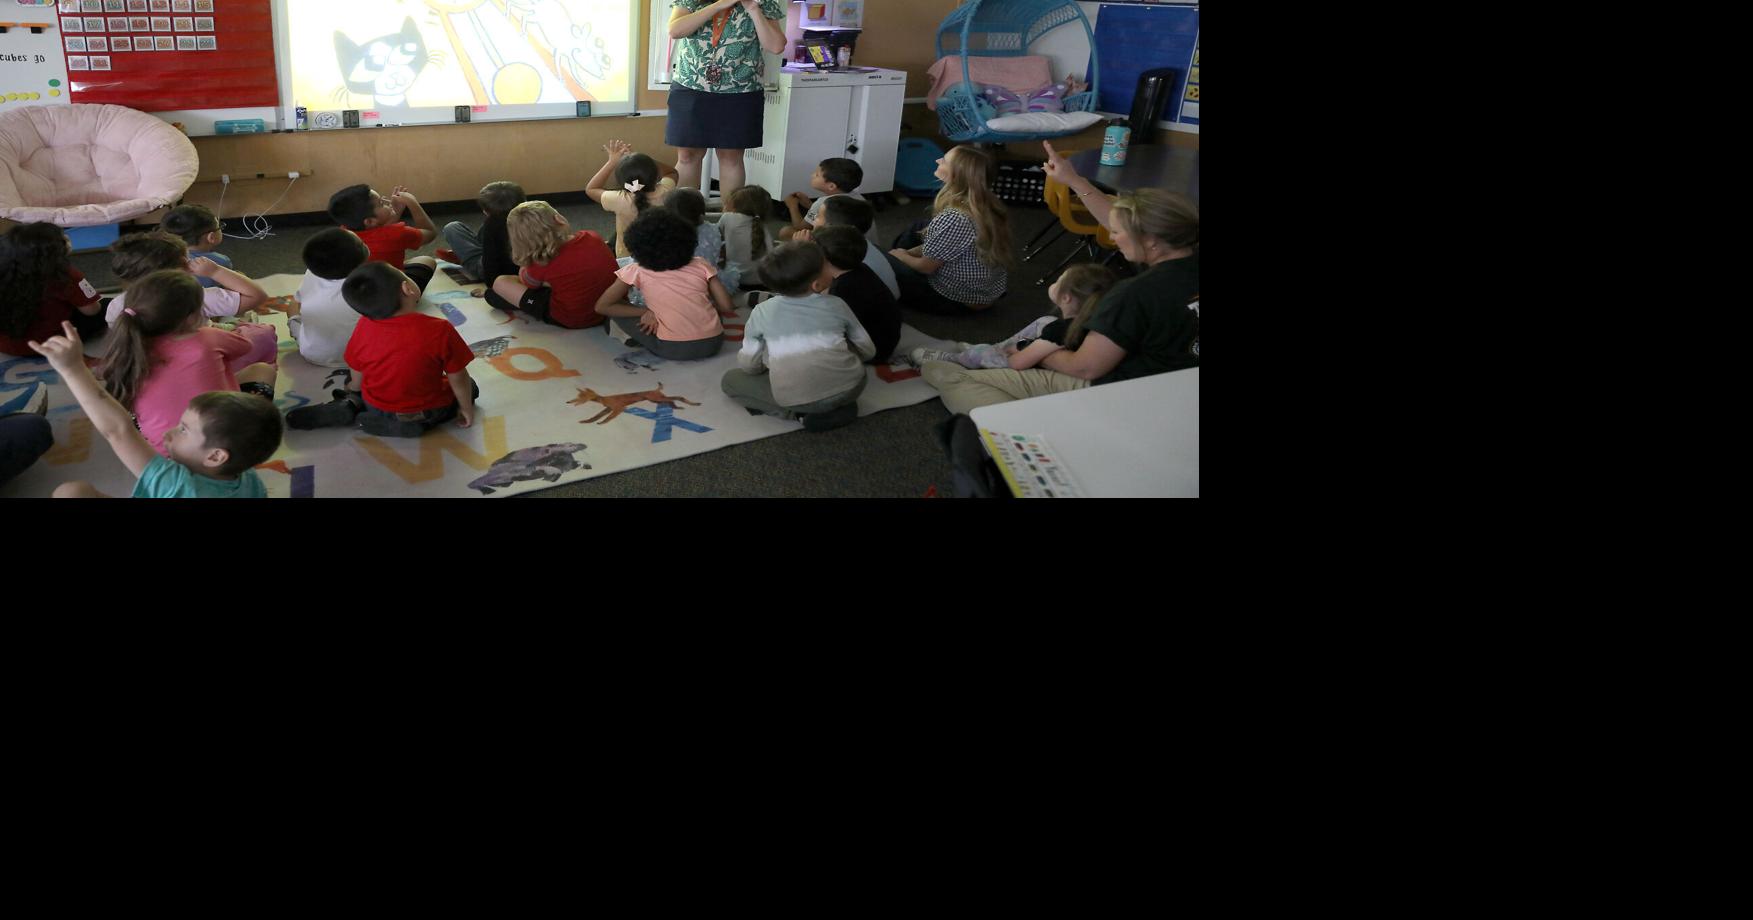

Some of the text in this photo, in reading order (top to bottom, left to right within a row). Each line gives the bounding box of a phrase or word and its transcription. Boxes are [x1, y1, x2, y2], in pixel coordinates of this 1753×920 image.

[0, 53, 27, 62] cubes
[488, 347, 582, 381] Q
[623, 403, 715, 443] X
[352, 414, 508, 484] W
